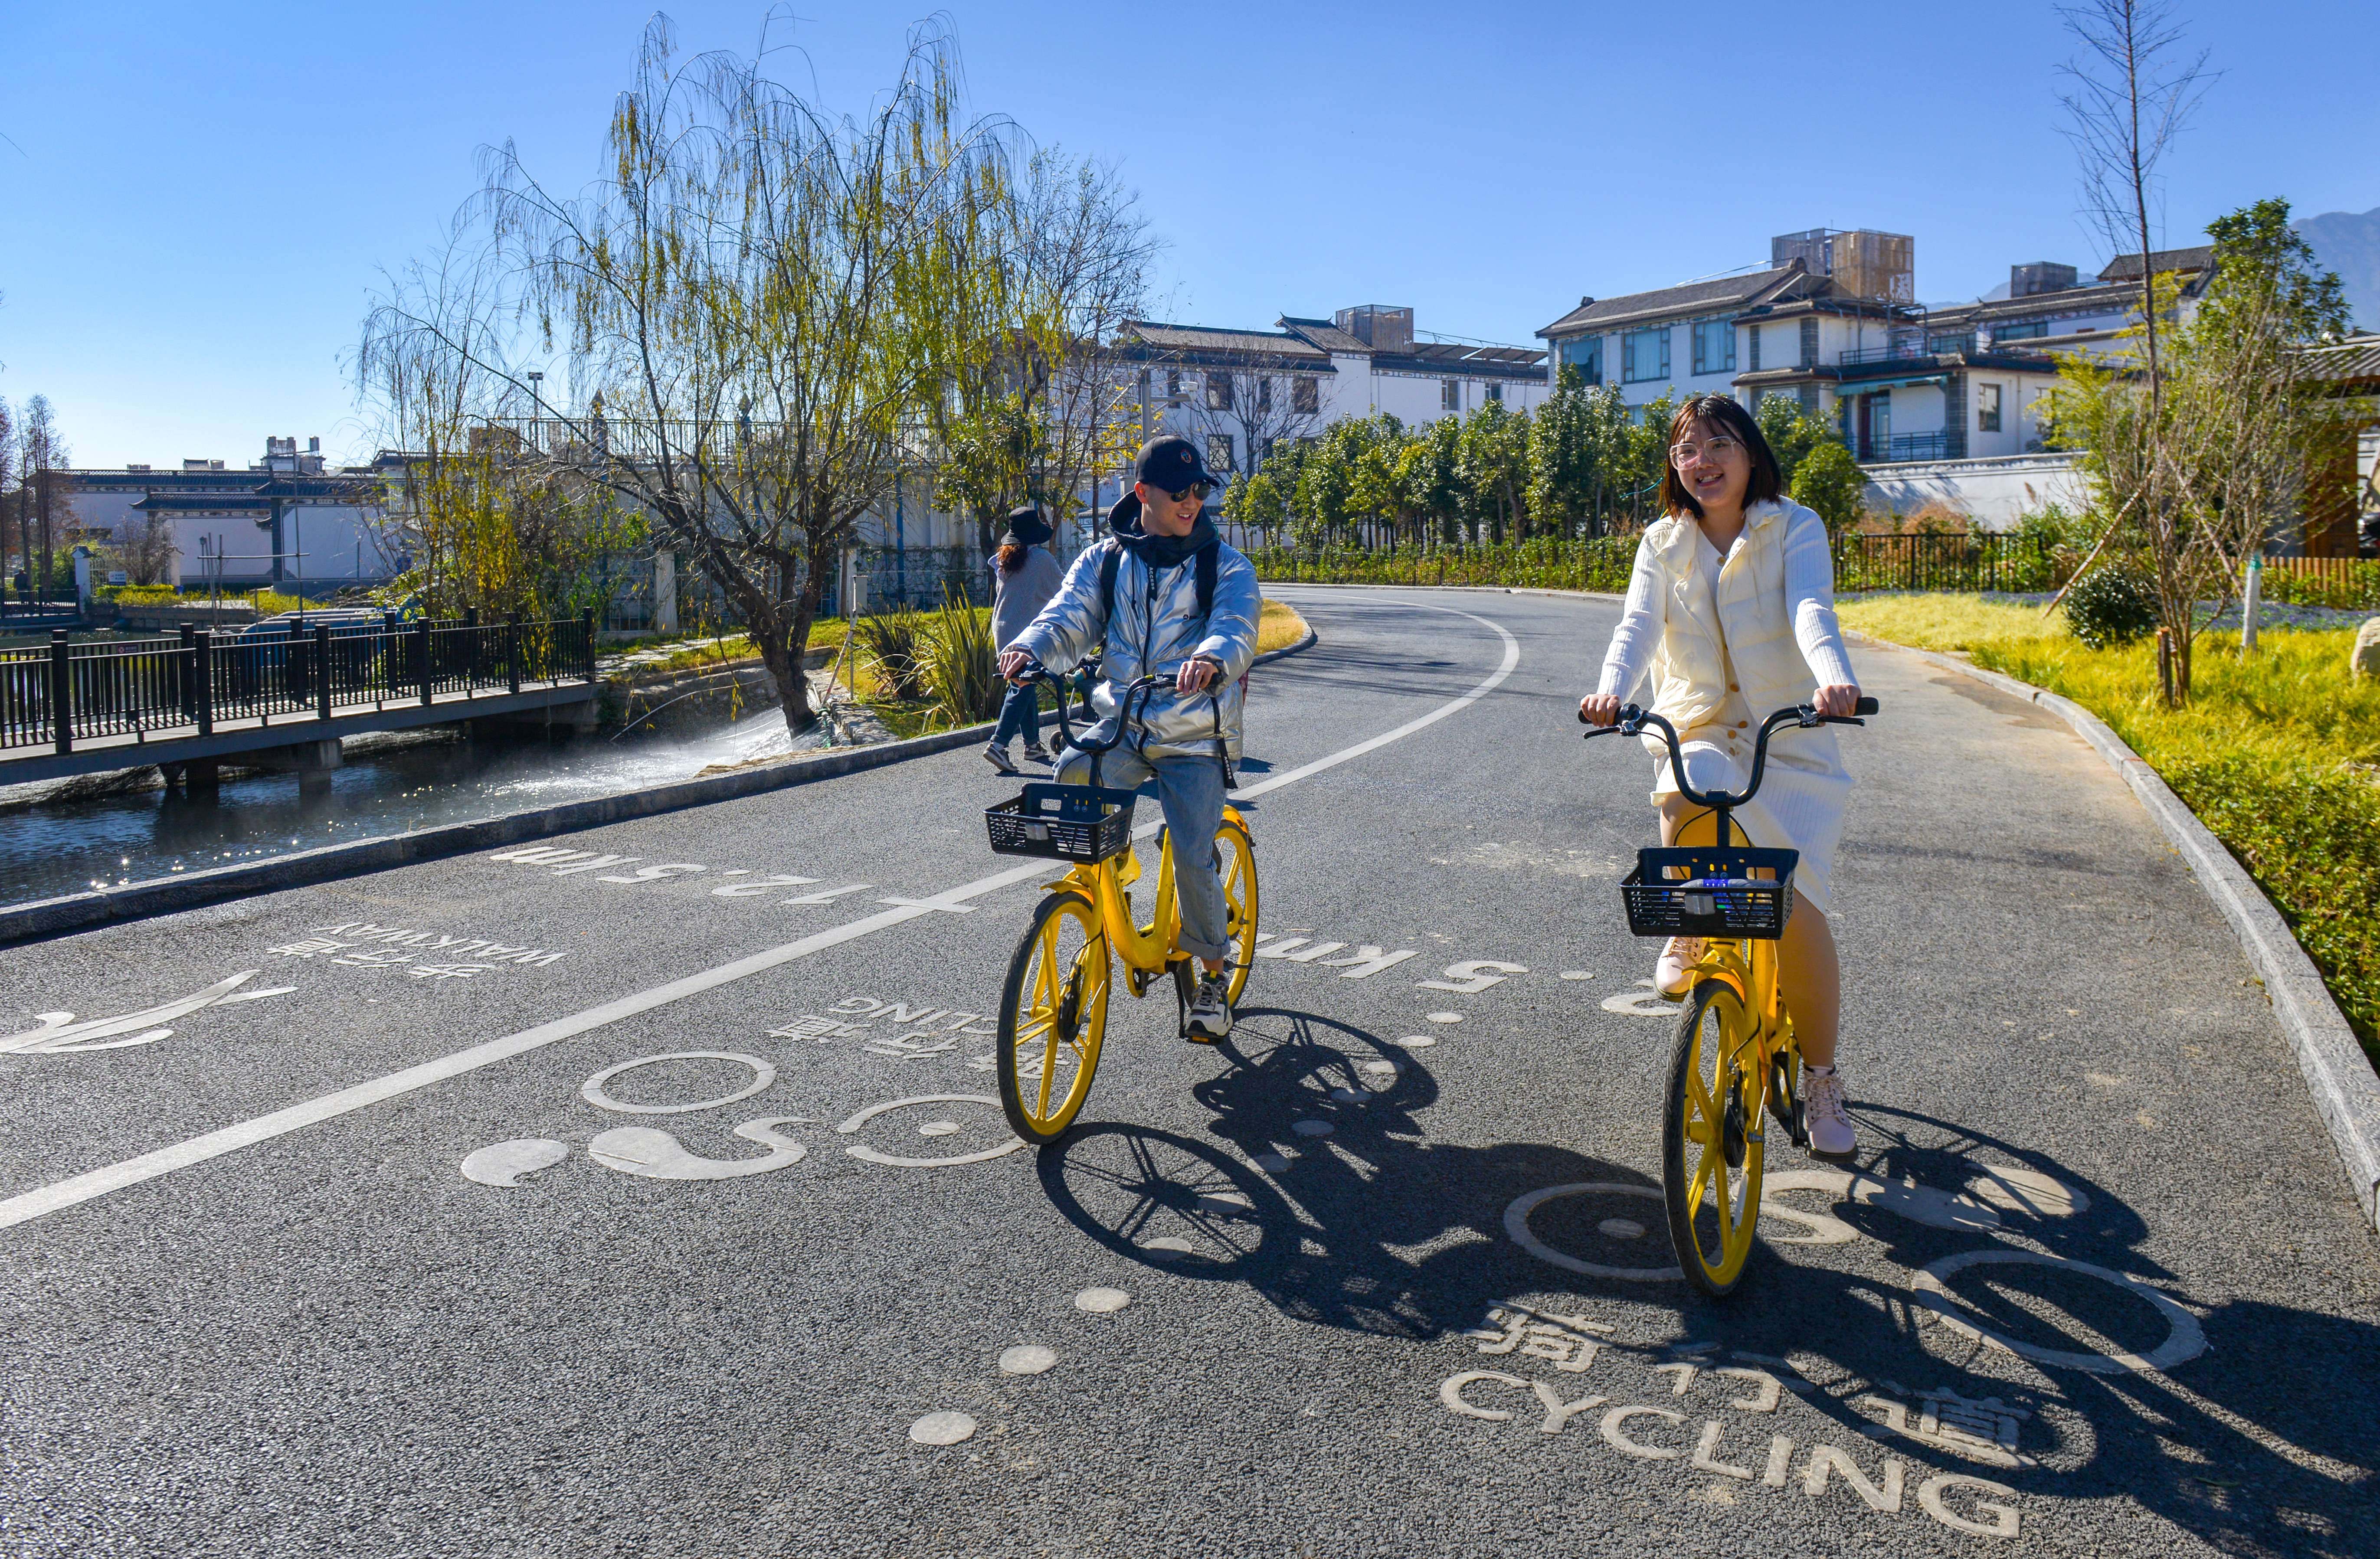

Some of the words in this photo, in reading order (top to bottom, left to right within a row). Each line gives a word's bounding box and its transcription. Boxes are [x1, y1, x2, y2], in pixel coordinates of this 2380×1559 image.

[265, 937, 496, 980] 步行道
[309, 922, 568, 967] WALKWAY
[1465, 1300, 2040, 1467] 骑行道
[1440, 1370, 2021, 1539] CYCLING
